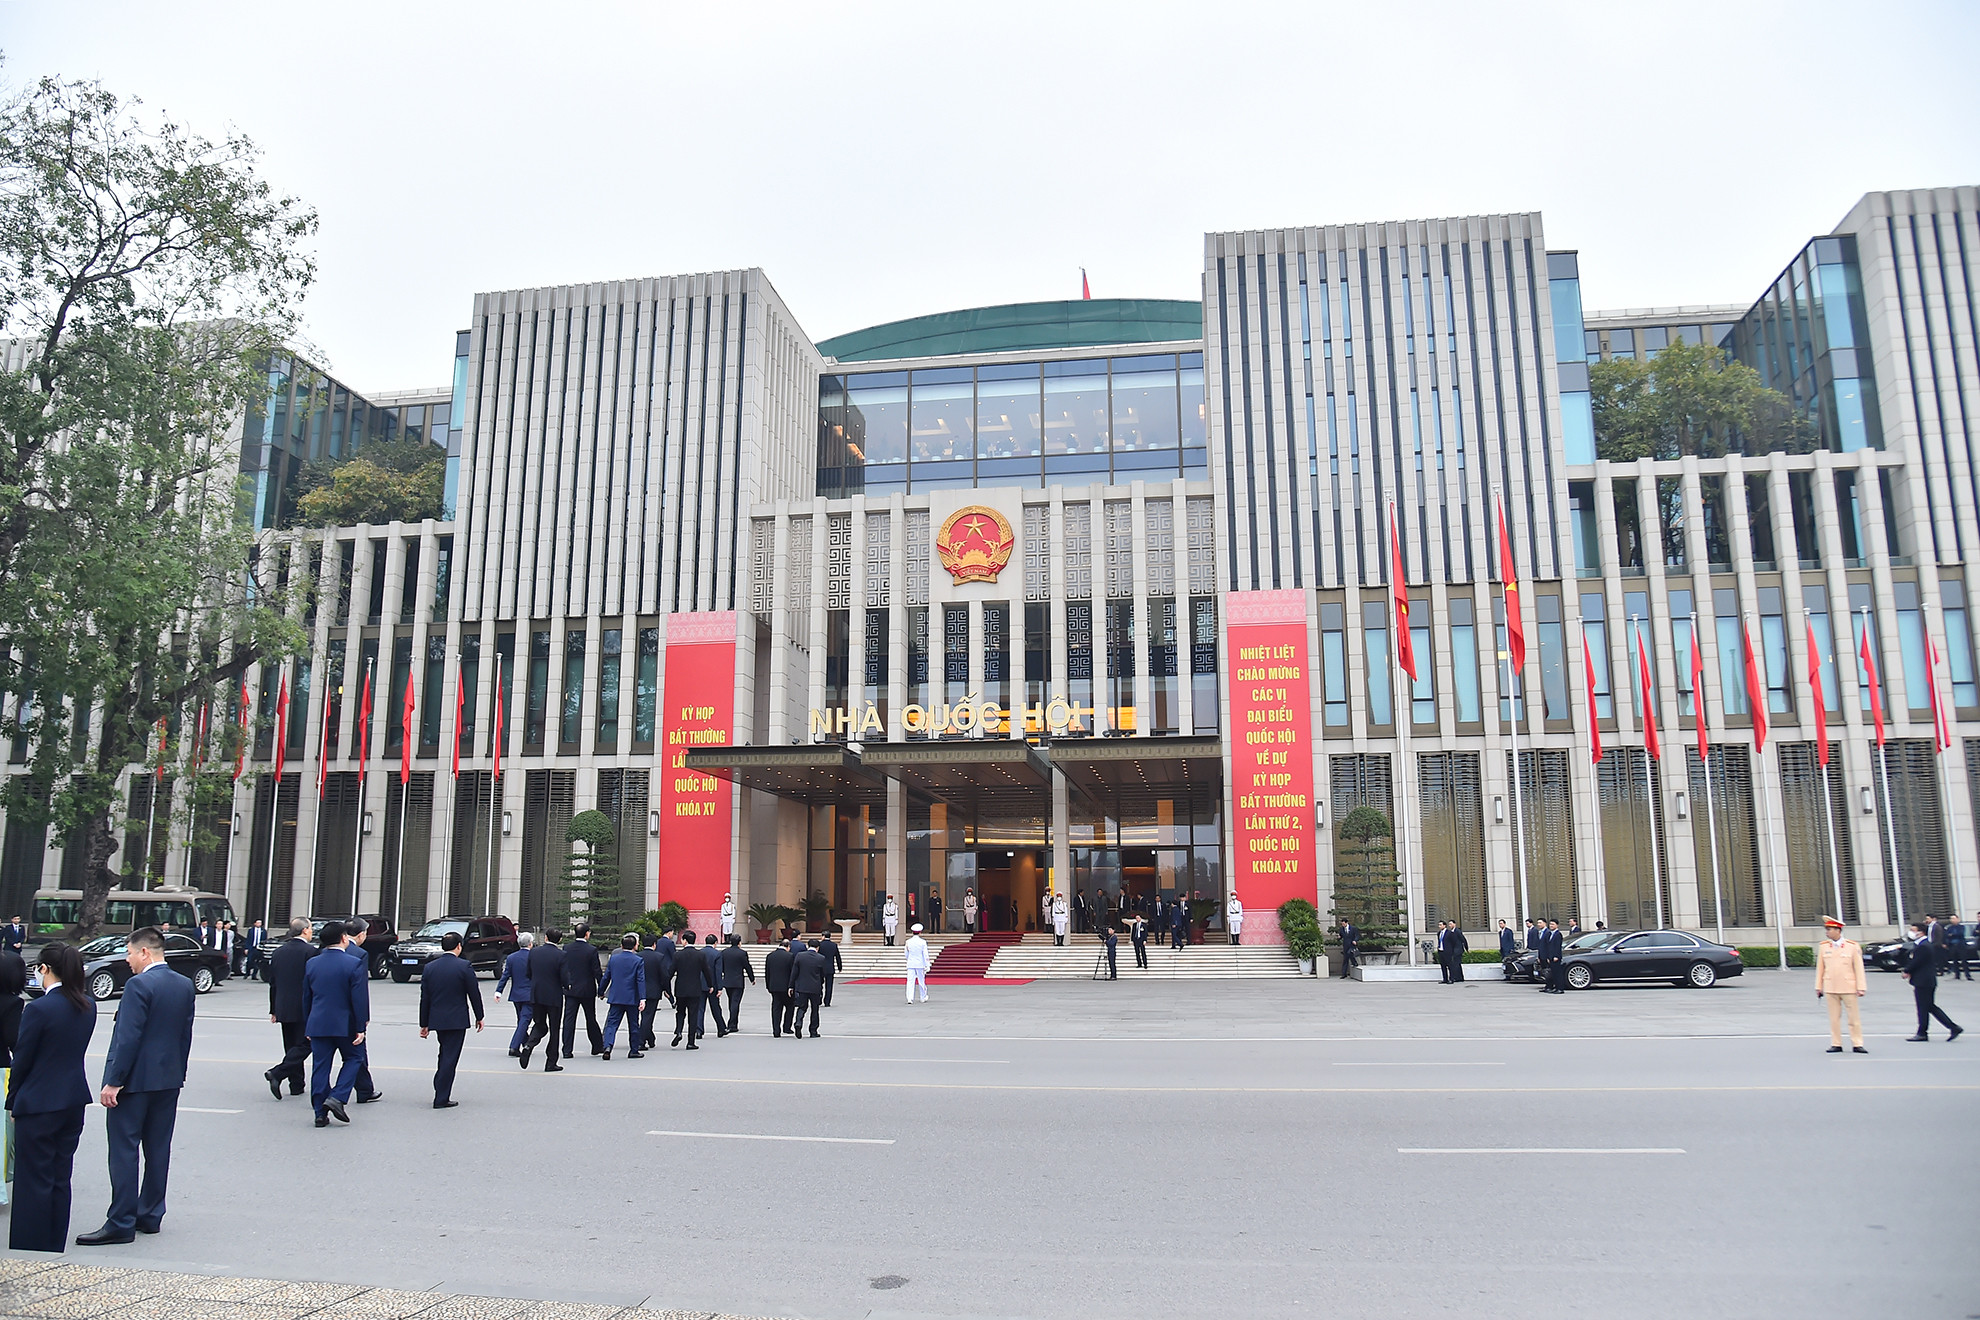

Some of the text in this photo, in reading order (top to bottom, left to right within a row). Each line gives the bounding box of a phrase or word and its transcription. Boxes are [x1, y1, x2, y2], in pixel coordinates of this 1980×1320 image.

[1240, 644, 1295, 662] NHIỆT LIỆT
[1237, 665, 1300, 681] CHÀO MỪNG
[1252, 686, 1287, 703] CÁC VỊ
[681, 704, 715, 723] KỲ HỌP
[810, 691, 1081, 734] NHÀ QUỐC HỘI
[1247, 704, 1293, 725] ĐẠI BIỂU
[669, 727, 726, 745] BẤT THƯỜNG
[1246, 727, 1296, 746] QUỐC HỘI
[672, 750, 686, 768] LẦ
[1256, 748, 1288, 767] VỀ DỰ
[675, 773, 718, 794] QUỐC HỘI
[1253, 771, 1291, 788] KỲ HỌP
[675, 799, 716, 816] KHÓA XV
[1240, 791, 1306, 808] BẤT THƯỜNG
[1245, 813, 1303, 830] LẦN THỨ 2,
[1249, 834, 1300, 853] QUỐC HỘI
[1252, 858, 1298, 873] KHÓA XV
